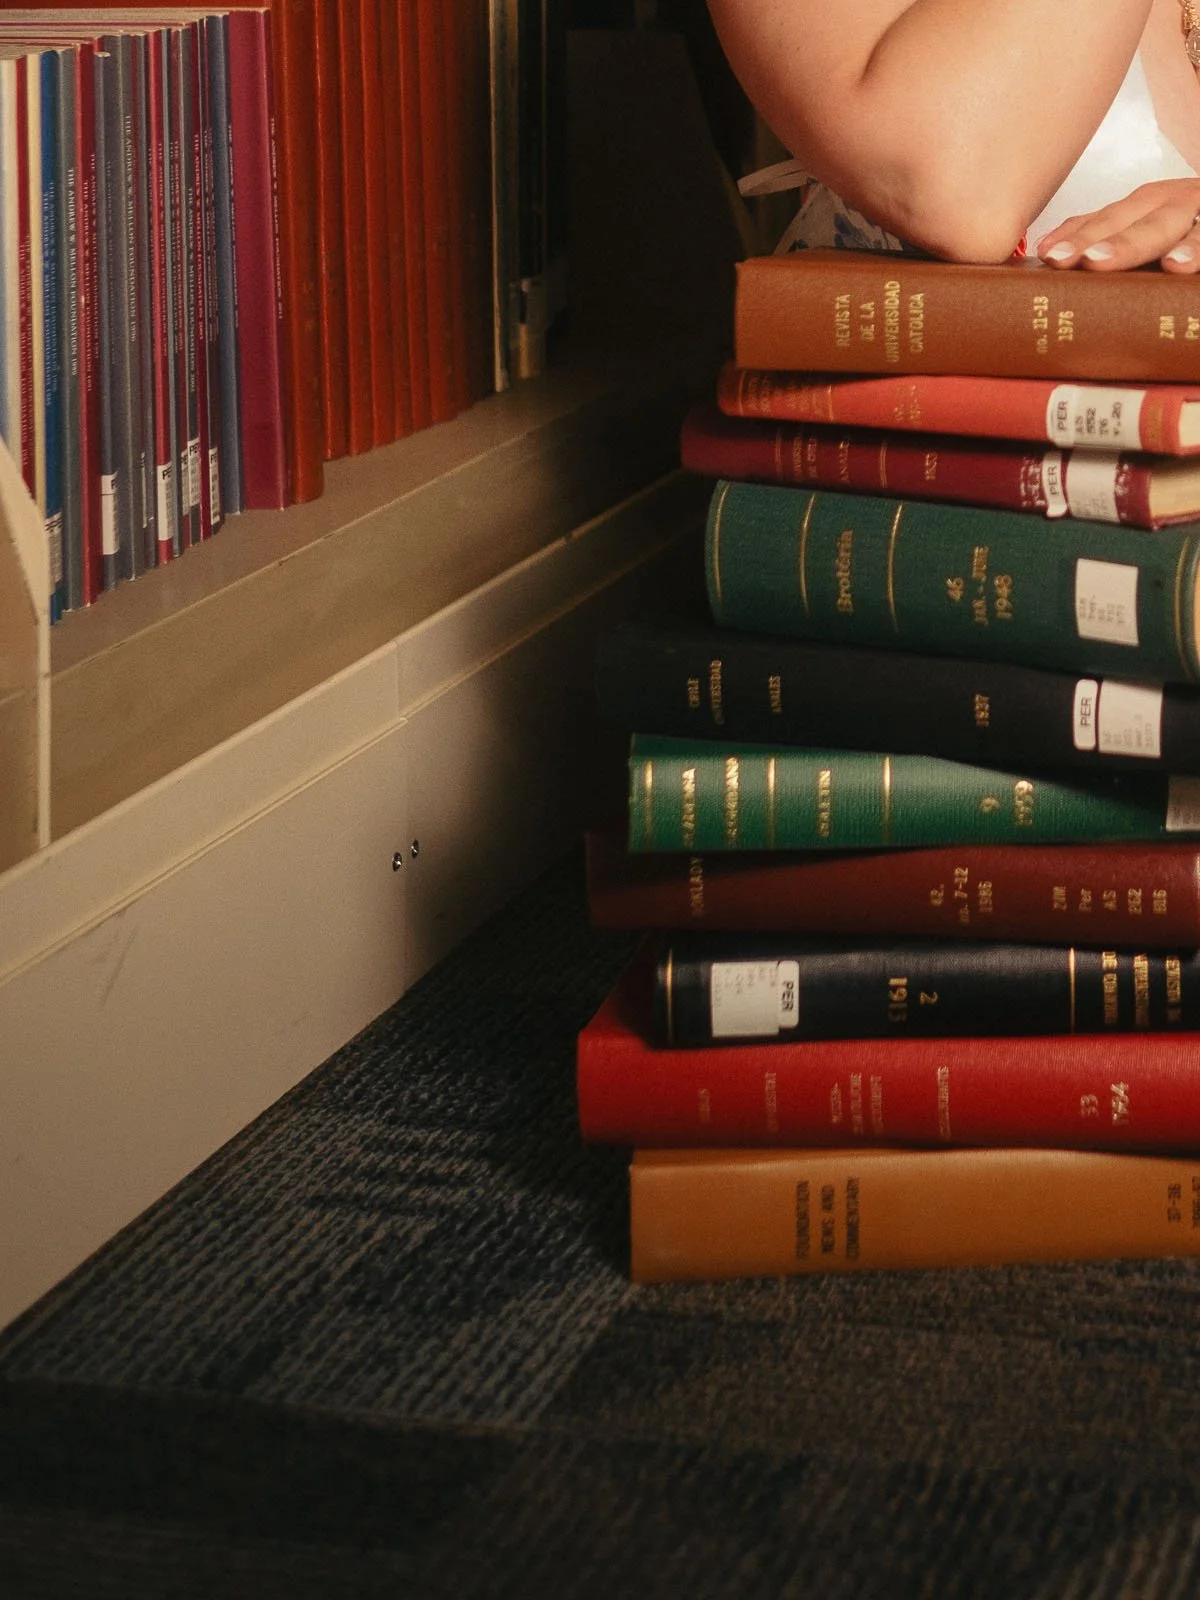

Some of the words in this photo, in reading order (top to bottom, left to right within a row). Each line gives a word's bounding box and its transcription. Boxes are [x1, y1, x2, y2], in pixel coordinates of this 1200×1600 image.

[67, 167, 75, 187] THE
[68, 189, 76, 232] ANDREW
[127, 200, 135, 244] MELLON
[69, 248, 77, 290] MELLON
[129, 246, 137, 316] FOUNDATION
[70, 291, 78, 356] FOUNDATION
[834, 294, 851, 347] REVISTA
[860, 301, 875, 320] LA
[884, 280, 900, 362] UNIVERSIDAD
[908, 293, 924, 353] CATOLICA
[860, 324, 875, 342] DE
[1159, 315, 1175, 339] ZIM
[1185, 316, 1200, 341] Per
[1035, 334, 1049, 355] no.
[1056, 400, 1069, 431] PER
[1047, 465, 1059, 496] PER
[768, 675, 781, 713] ANALES
[1080, 697, 1092, 727] PER
[954, 867, 968, 900] 7-12
[1078, 888, 1092, 912] Per
[1103, 890, 1117, 910] AS
[782, 981, 794, 1013] PER
[919, 991, 939, 1006] 2
[821, 1184, 834, 1212] AND
[796, 1180, 809, 1259] FOUNDATION
[846, 1177, 861, 1260] COMMENTARY
[821, 1218, 834, 1254] NEWS
